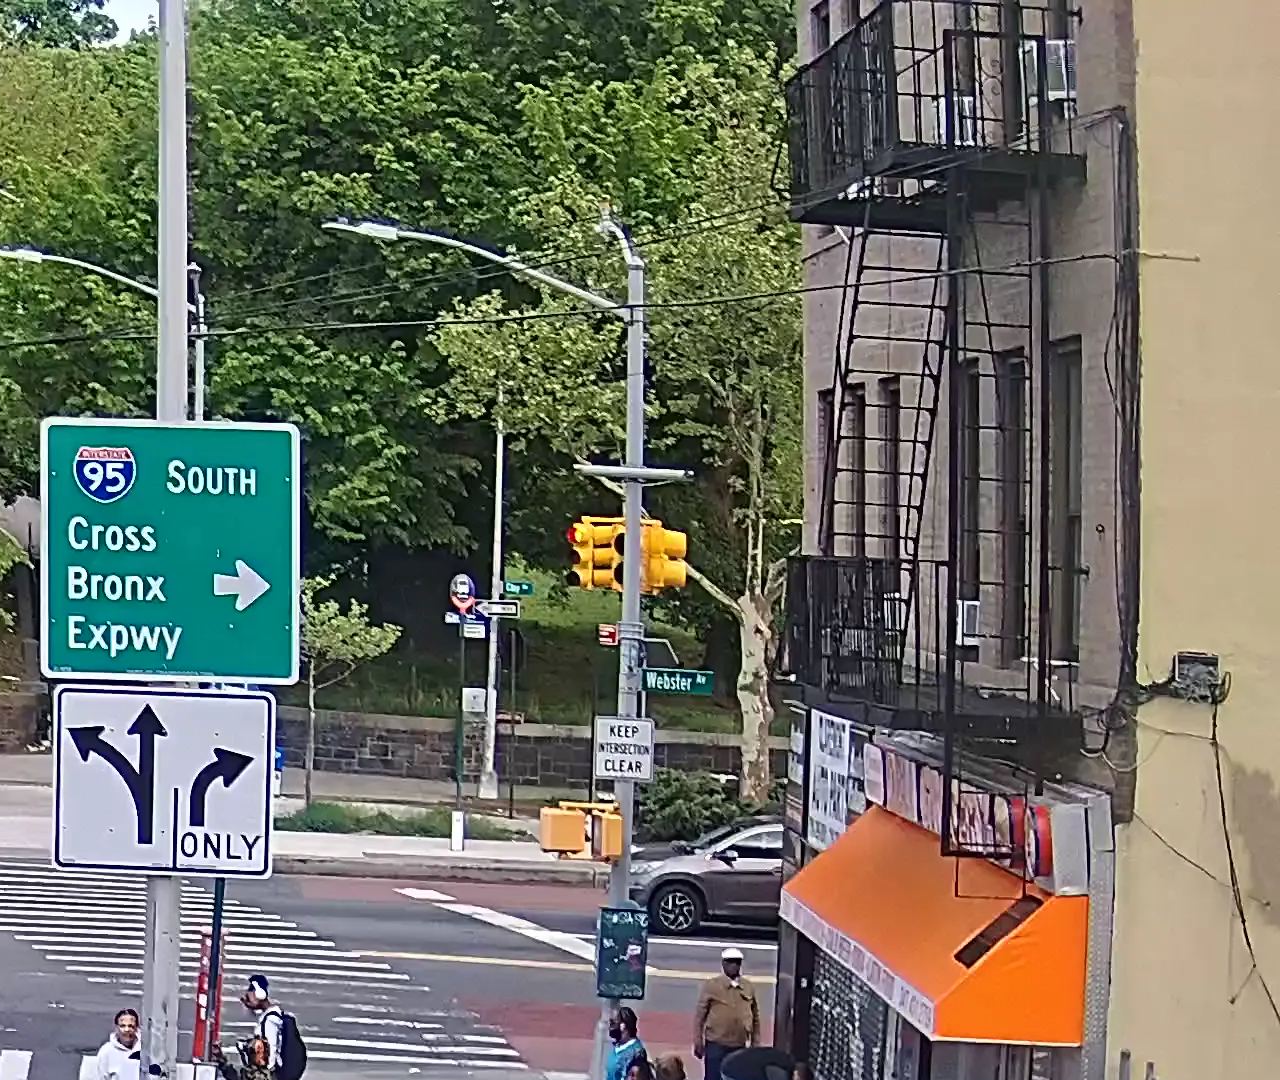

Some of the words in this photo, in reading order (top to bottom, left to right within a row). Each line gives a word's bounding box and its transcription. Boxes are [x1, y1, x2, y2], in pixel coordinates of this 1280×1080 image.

[83, 462, 126, 492] 95
[167, 459, 257, 496] SOUTH
[68, 516, 157, 551] Cross
[68, 566, 166, 602] Bronx
[68, 615, 182, 660] Expwy
[646, 671, 693, 692] Webster
[609, 724, 640, 739] KEEP
[598, 742, 650, 757] INTERSECTION
[604, 758, 643, 774] CLEAR
[180, 831, 262, 862] ONLY
